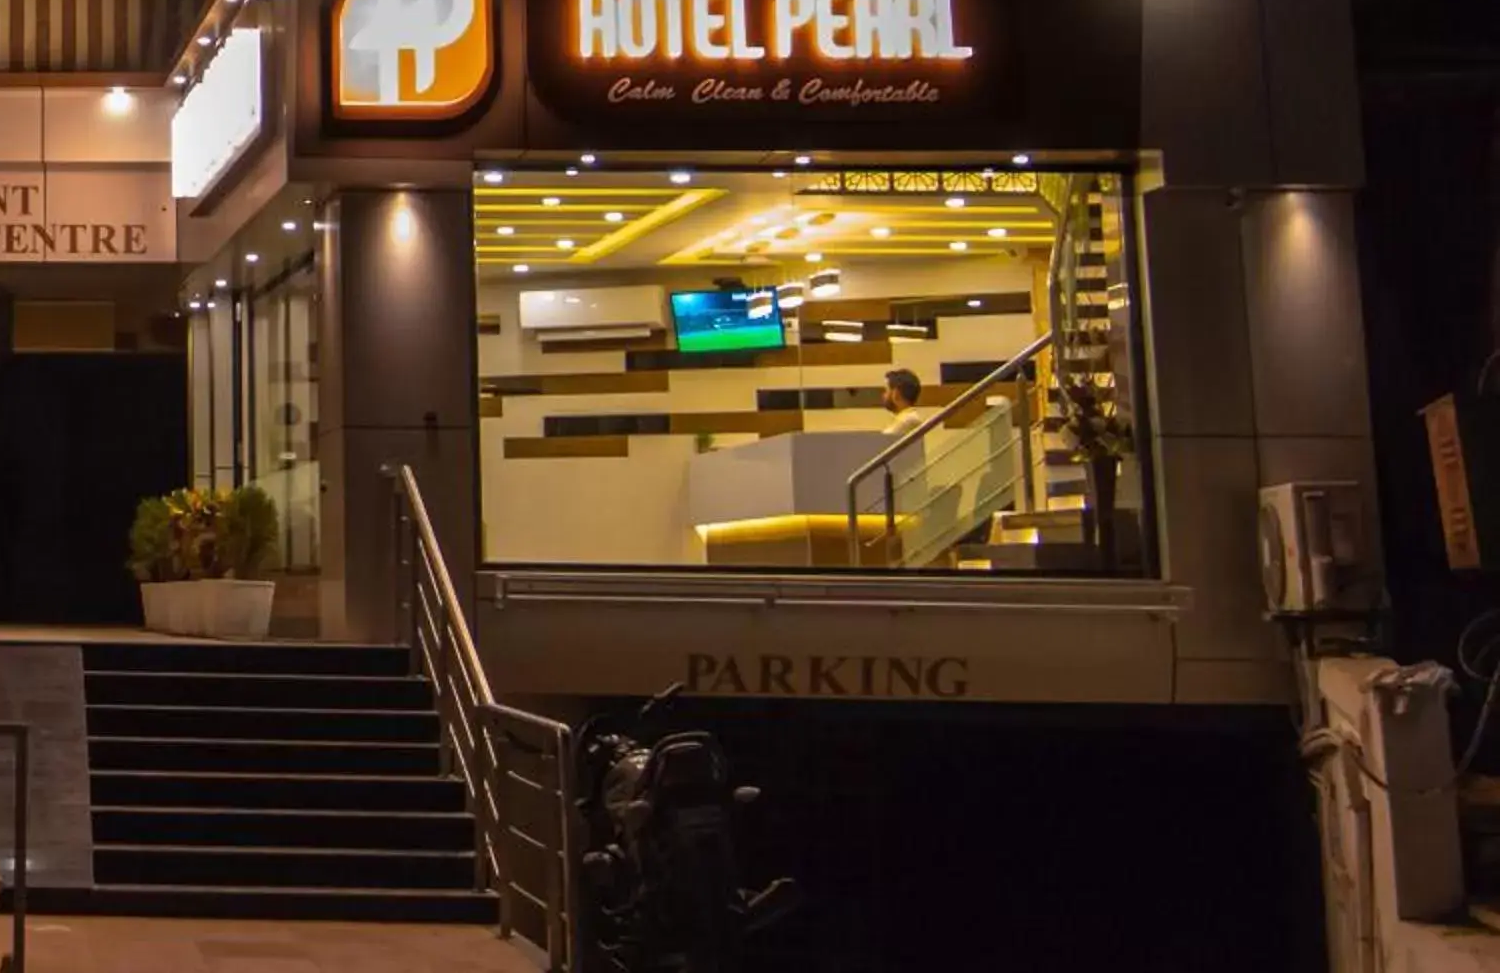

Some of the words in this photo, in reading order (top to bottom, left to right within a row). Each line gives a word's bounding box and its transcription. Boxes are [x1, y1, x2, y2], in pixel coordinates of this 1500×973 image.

[607, 77, 677, 104] Calm
[691, 77, 765, 104] Clean
[770, 78, 790, 103] &
[797, 76, 941, 108] Comfortable
[684, 653, 971, 699] PARKING
